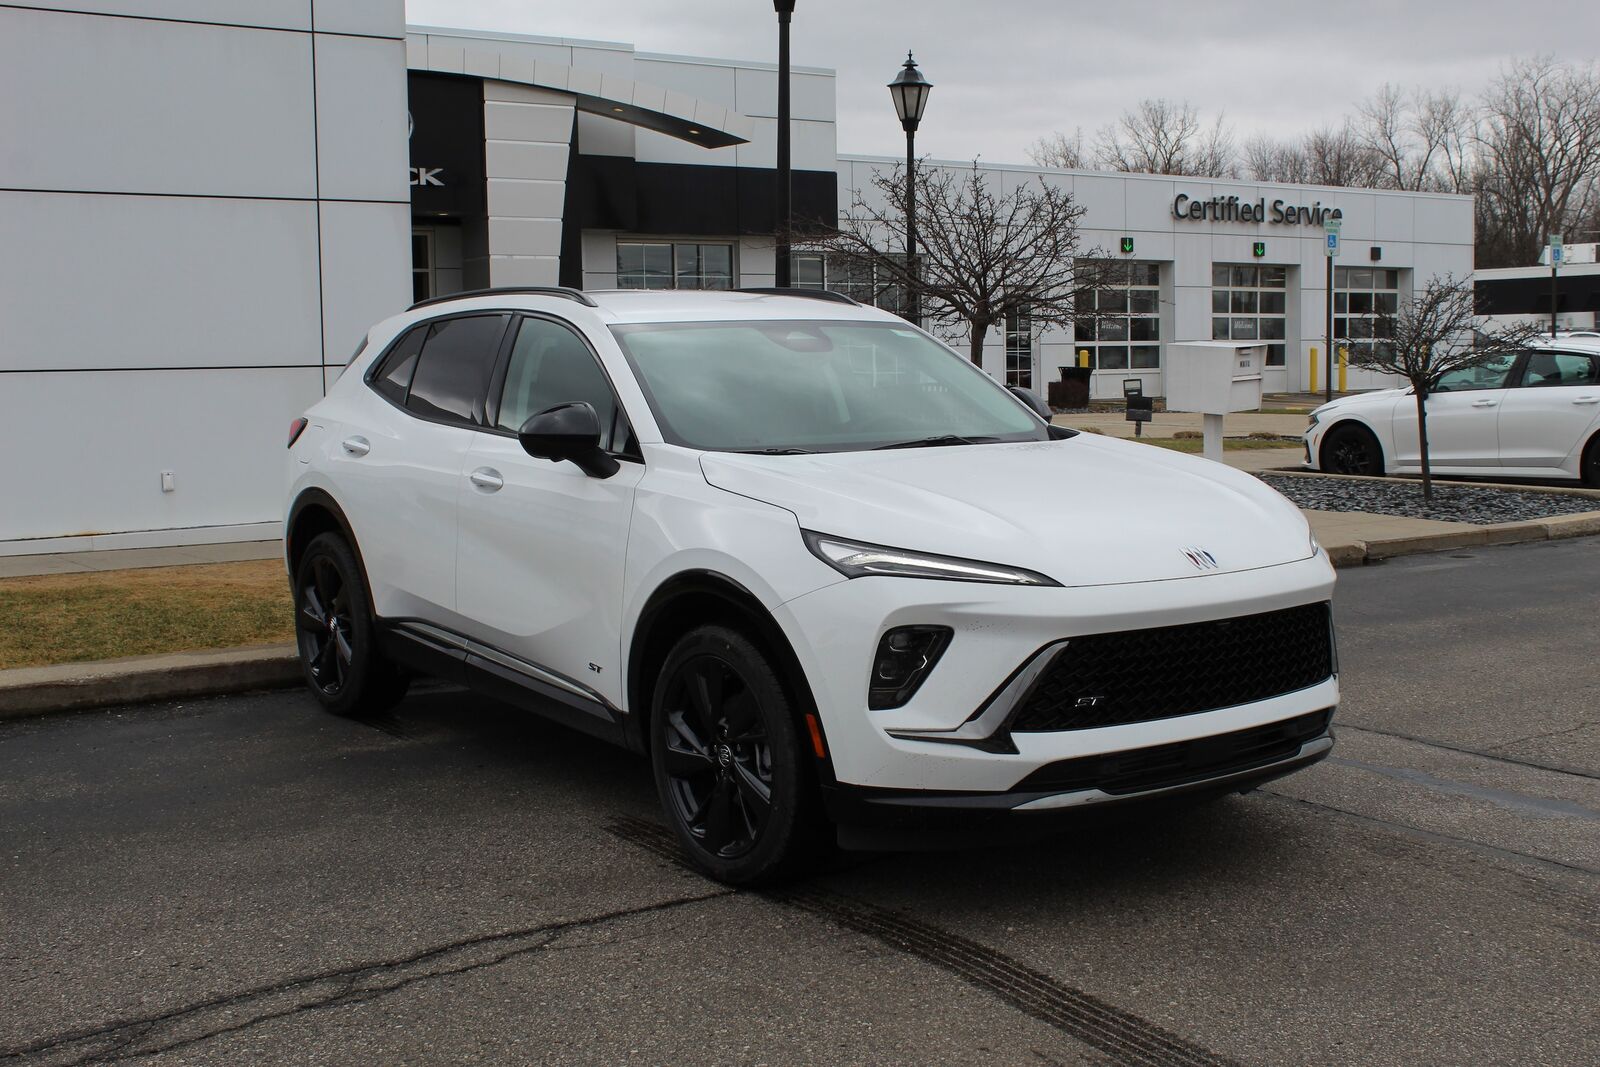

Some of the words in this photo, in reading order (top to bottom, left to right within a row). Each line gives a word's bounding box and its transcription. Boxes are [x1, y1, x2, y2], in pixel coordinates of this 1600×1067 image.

[1173, 193, 1265, 222] Certified
[1271, 199, 1343, 226] Service
[588, 662, 603, 673] ST
[1075, 695, 1105, 707] ST
